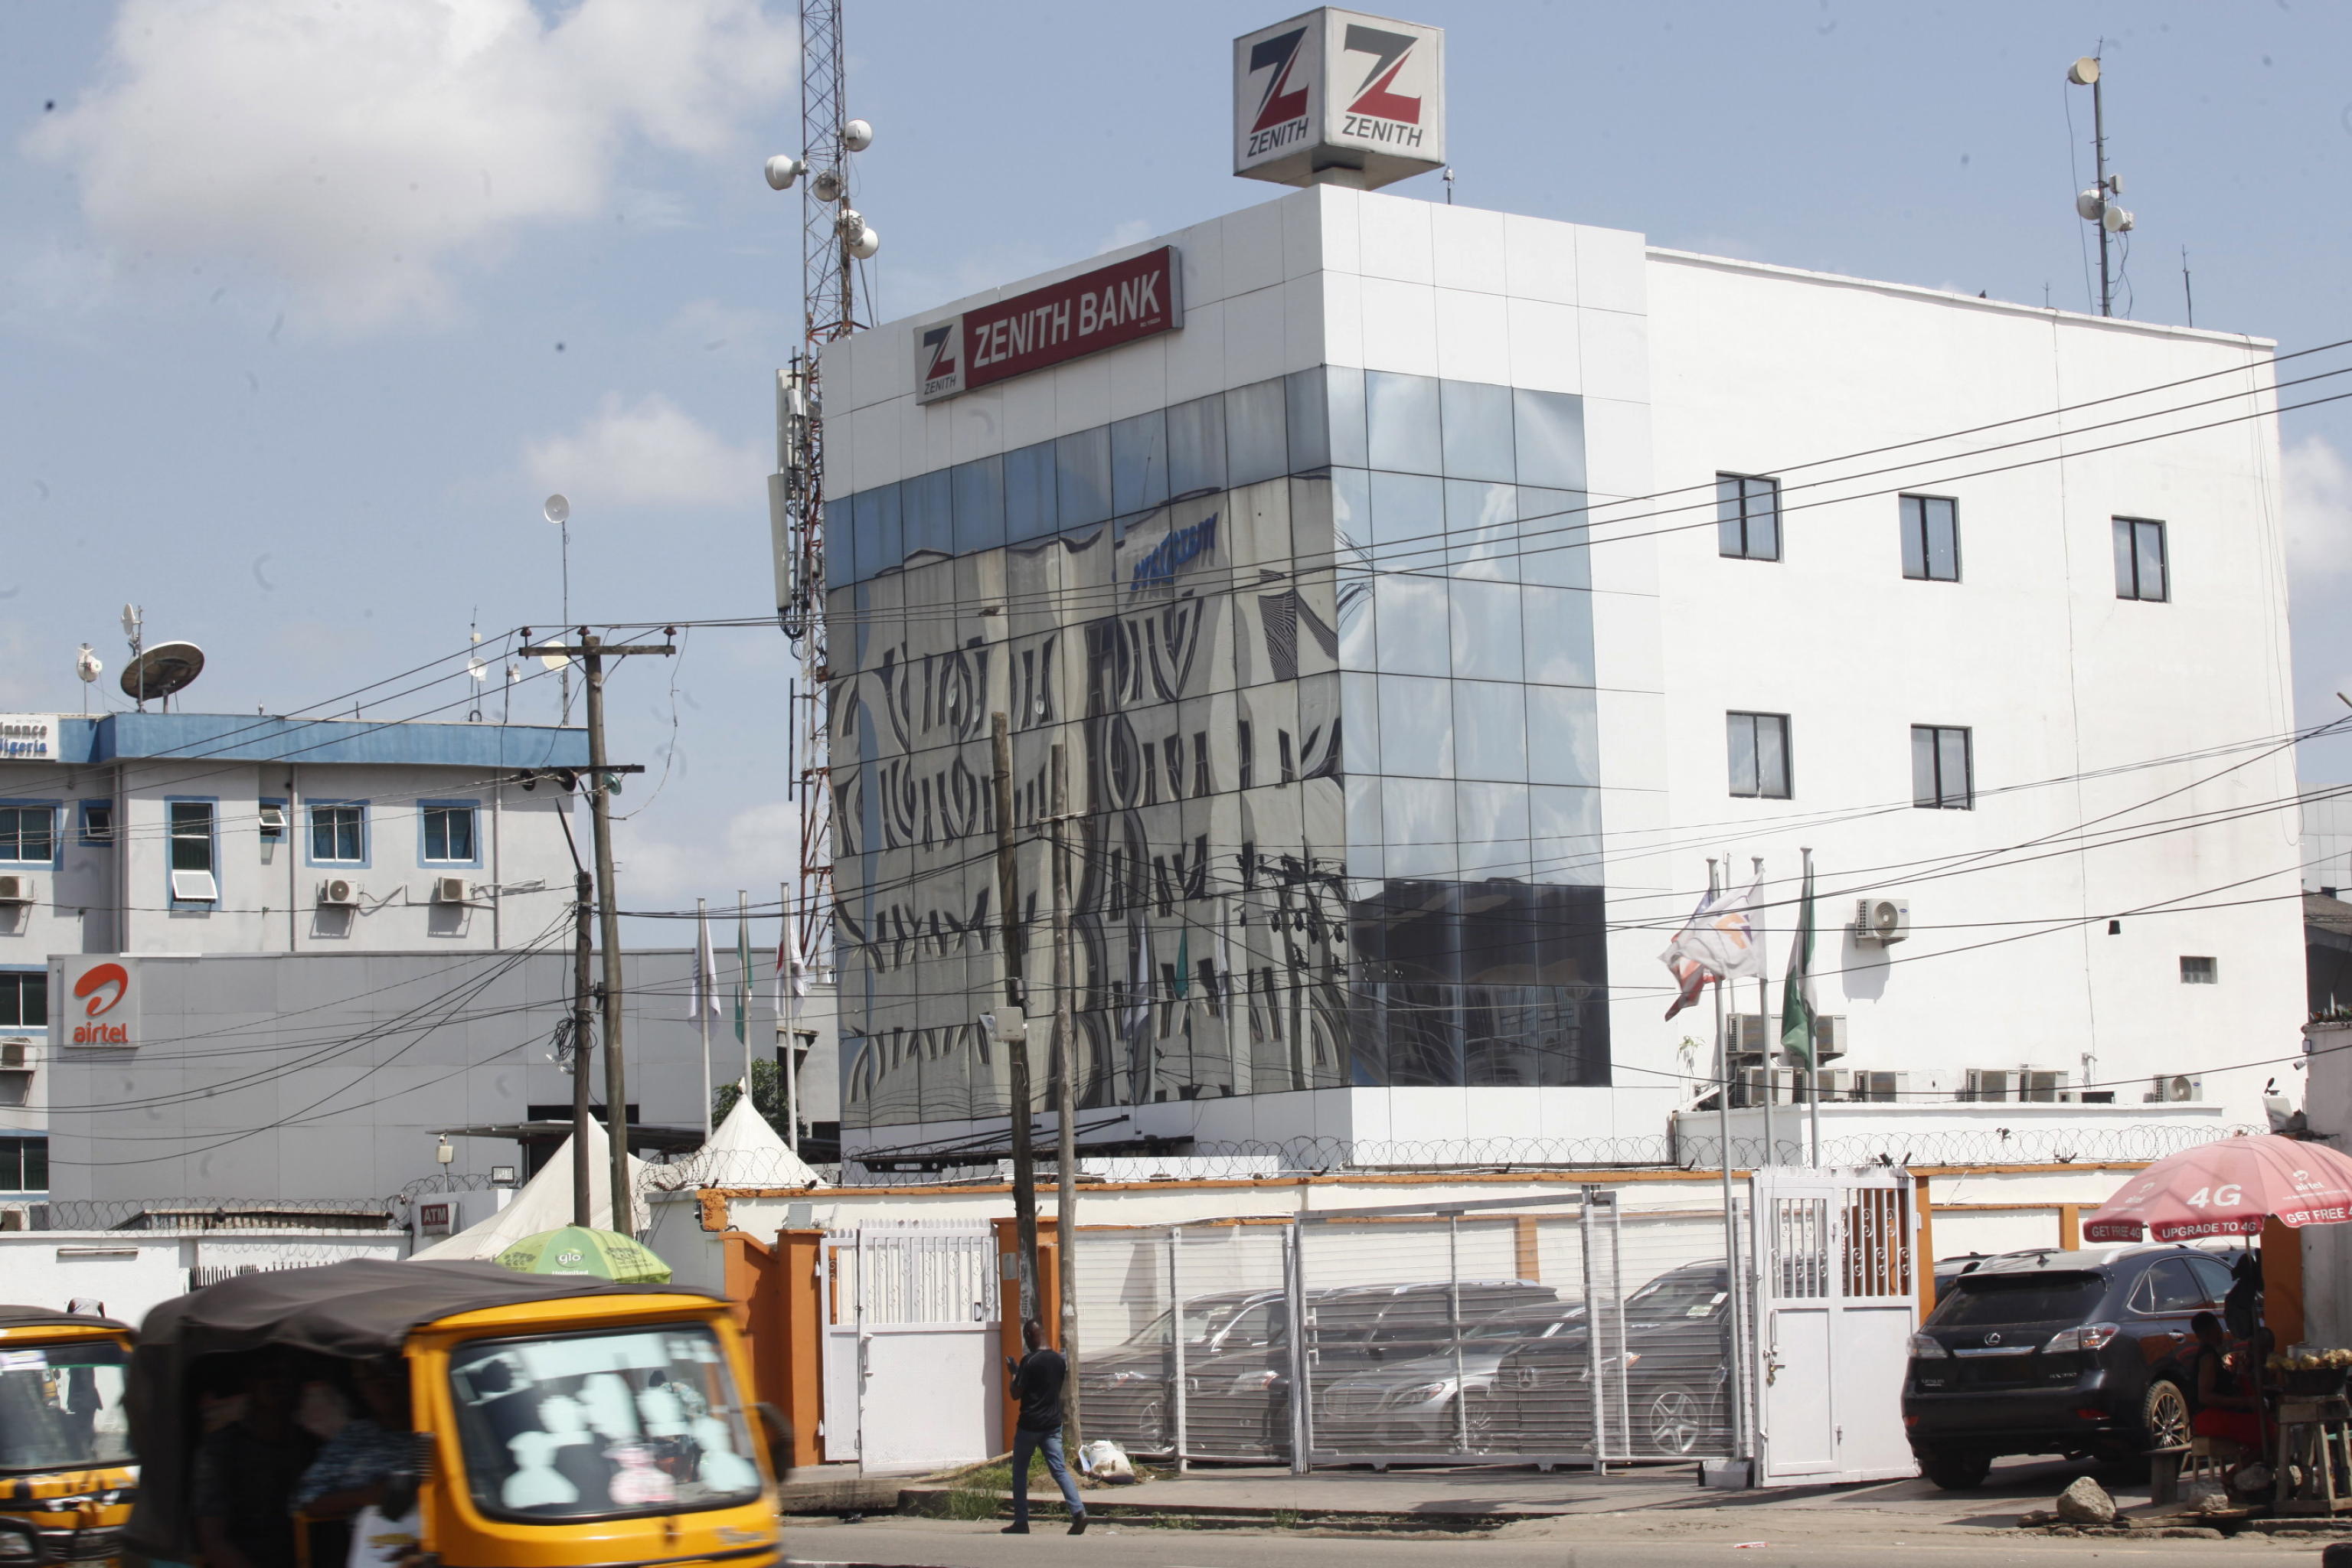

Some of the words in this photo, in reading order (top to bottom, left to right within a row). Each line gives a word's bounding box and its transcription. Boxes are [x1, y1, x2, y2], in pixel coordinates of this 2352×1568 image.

[1246, 117, 1308, 158] ZENITH
[1342, 116, 1423, 148] ZENITH
[974, 299, 1070, 368] ZENITH
[1078, 270, 1161, 337] BANK
[924, 374, 956, 395] ZENITH
[73, 1021, 129, 1044] airtel
[2295, 1181, 2325, 1191] airtel
[2187, 1184, 2242, 1208] 4G
[423, 1207, 446, 1223] ATM
[2286, 1211, 2311, 1223] GET
[2312, 1207, 2346, 1220] FREE
[2092, 1226, 2110, 1237] GET
[2111, 1226, 2128, 1238] FREE
[2129, 1227, 2141, 1239] 4G
[2162, 1223, 2220, 1239] UPGRADE
[2221, 1222, 2239, 1232] TO
[2240, 1222, 2257, 1232] 4G
[559, 1253, 581, 1264] glo
